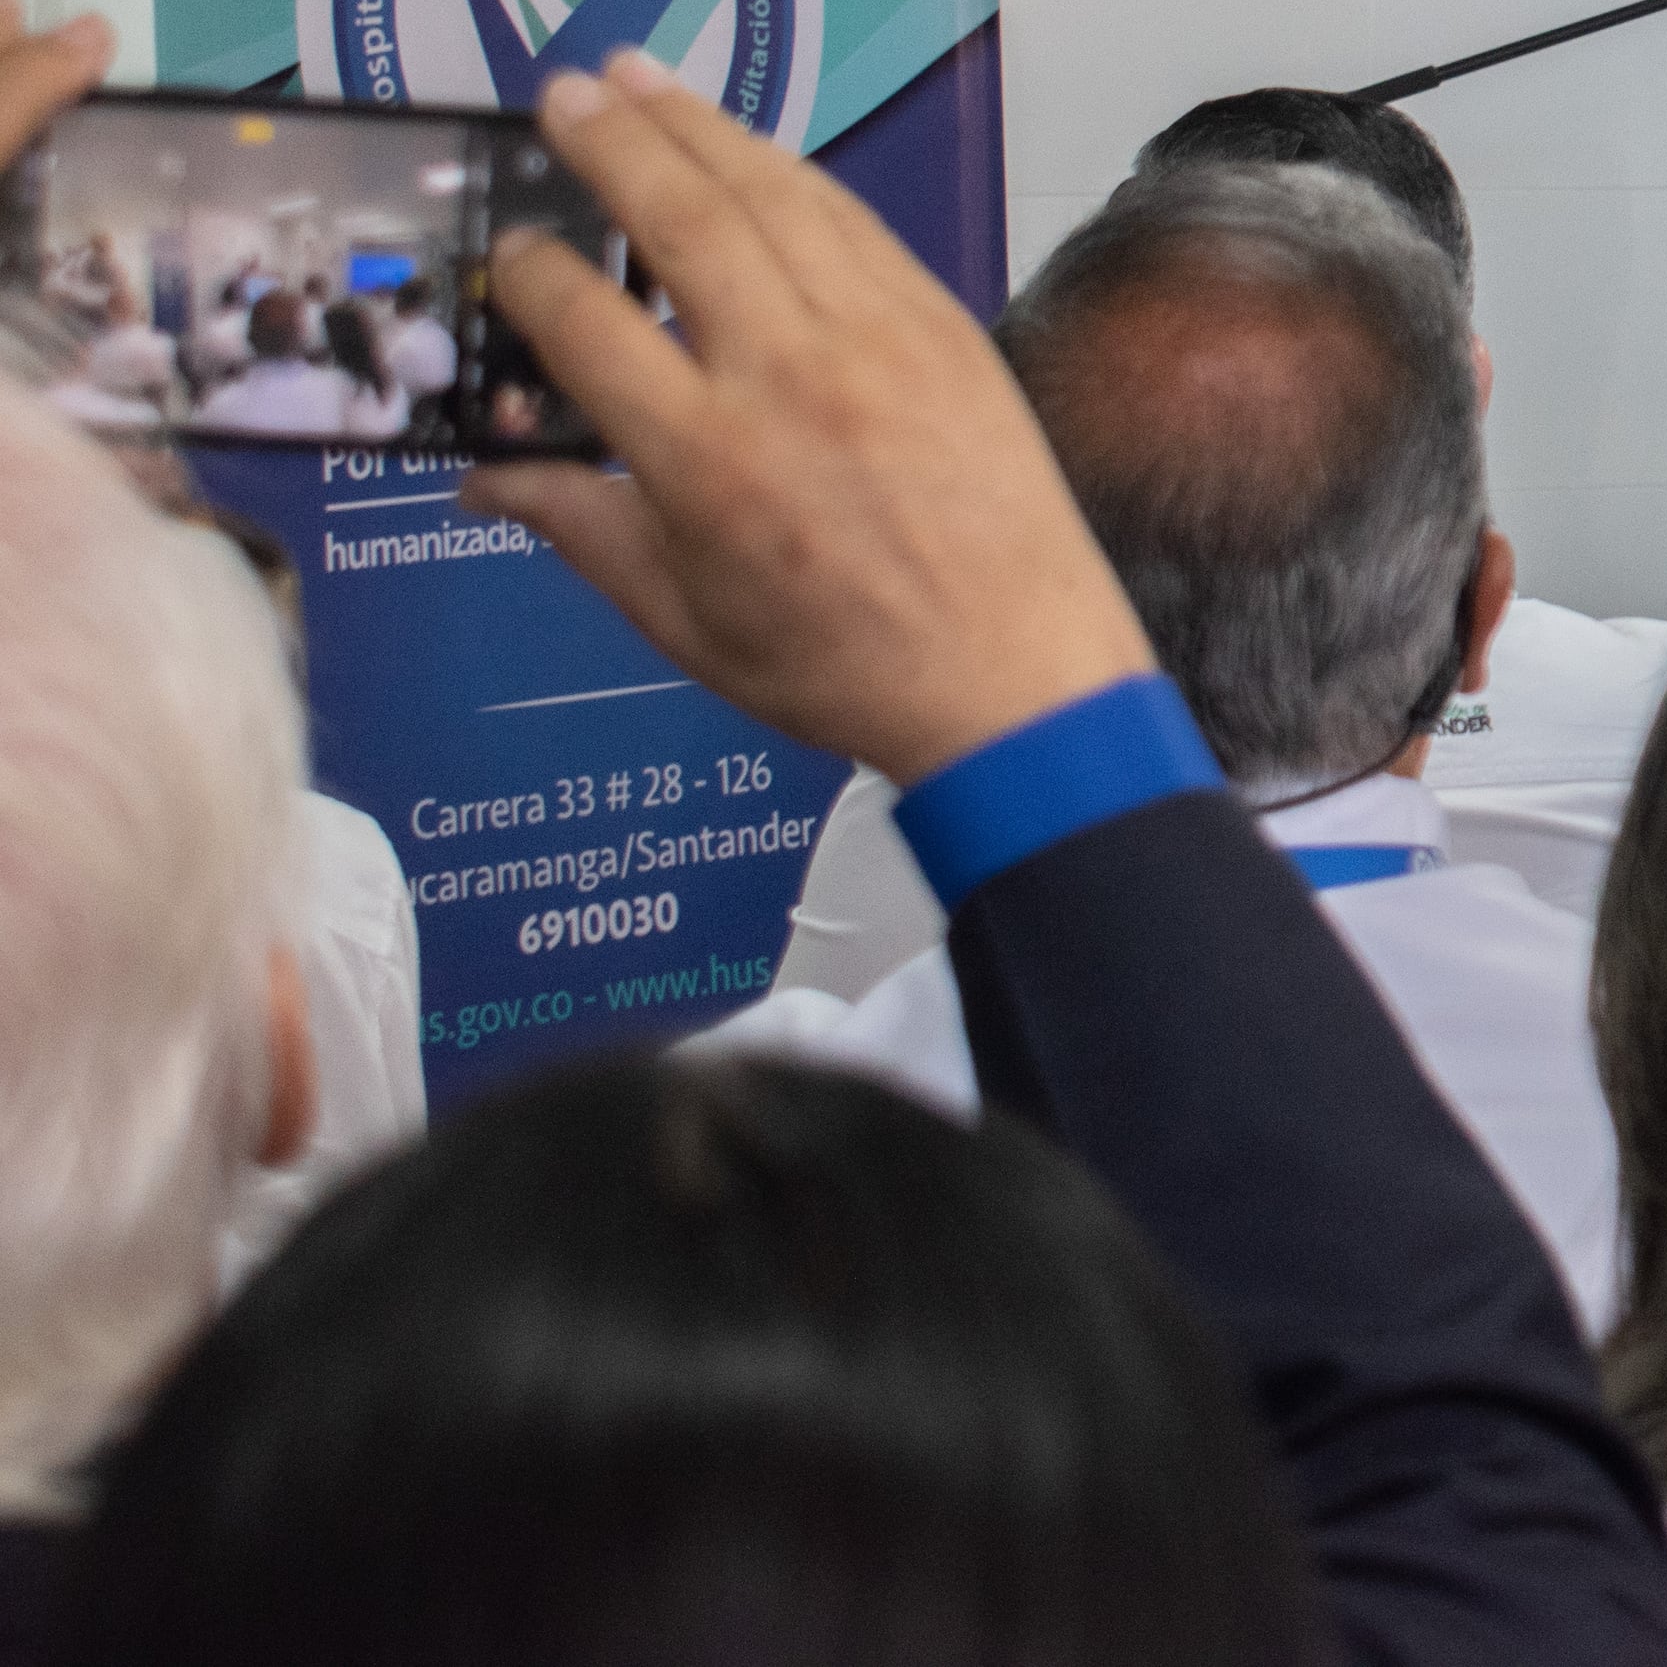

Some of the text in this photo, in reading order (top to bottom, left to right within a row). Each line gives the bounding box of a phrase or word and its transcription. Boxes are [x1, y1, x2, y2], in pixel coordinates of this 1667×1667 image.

[324, 517, 535, 573] humanizada,
[411, 793, 546, 840] Carrera
[556, 776, 596, 821] 33
[606, 771, 632, 812] #
[642, 764, 683, 808] 28
[716, 752, 773, 796] 126
[409, 809, 817, 906] caramanga/Santander
[519, 892, 680, 955] 6910030
[419, 989, 574, 1049] s.gov.co
